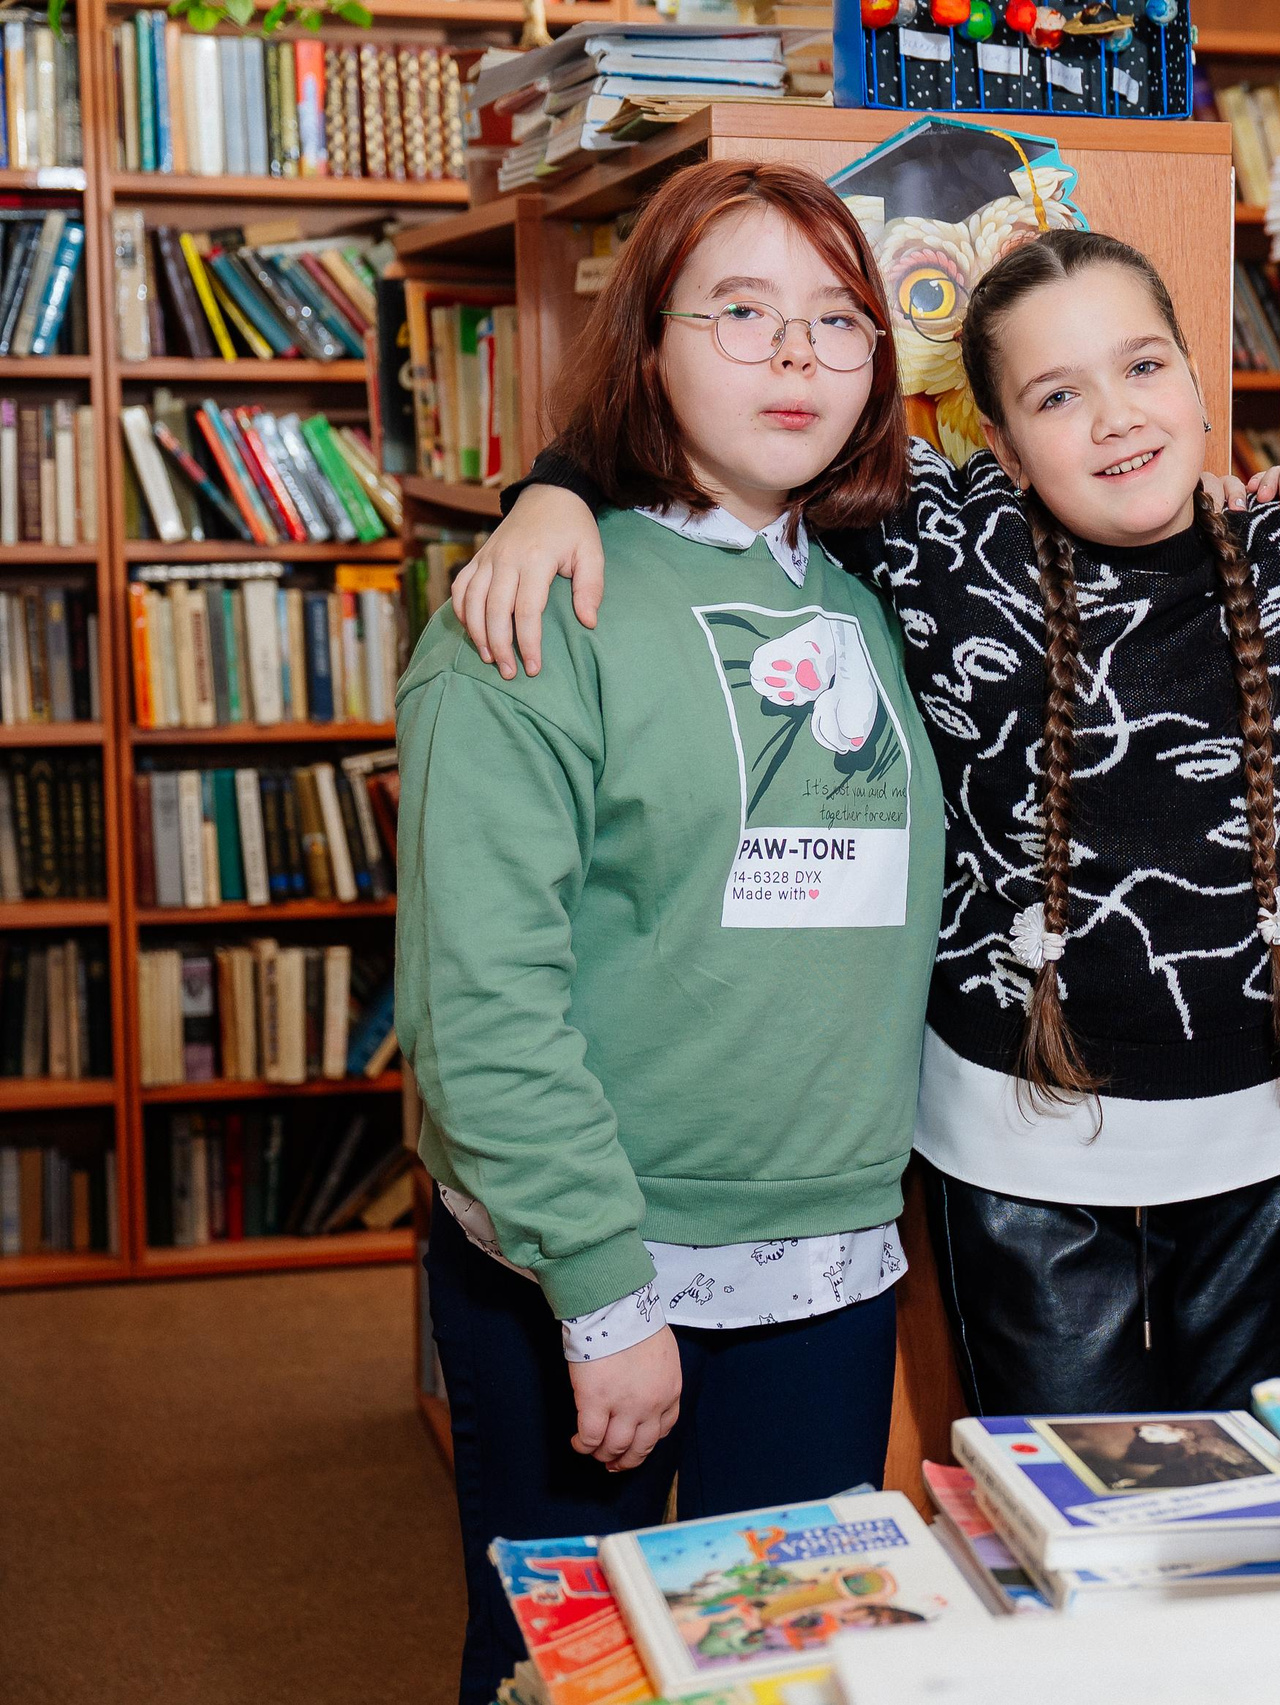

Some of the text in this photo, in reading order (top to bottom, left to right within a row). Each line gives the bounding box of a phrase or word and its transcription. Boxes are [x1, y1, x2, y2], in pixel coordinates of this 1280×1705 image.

[802, 778, 829, 796] It's
[852, 786, 866, 806] you
[868, 781, 888, 799] and
[892, 786, 907, 798] me
[819, 803, 903, 830] together forever
[738, 838, 856, 860] PAW-TONE
[732, 870, 822, 884] 14-6328 DYX
[732, 886, 806, 900] Made with
